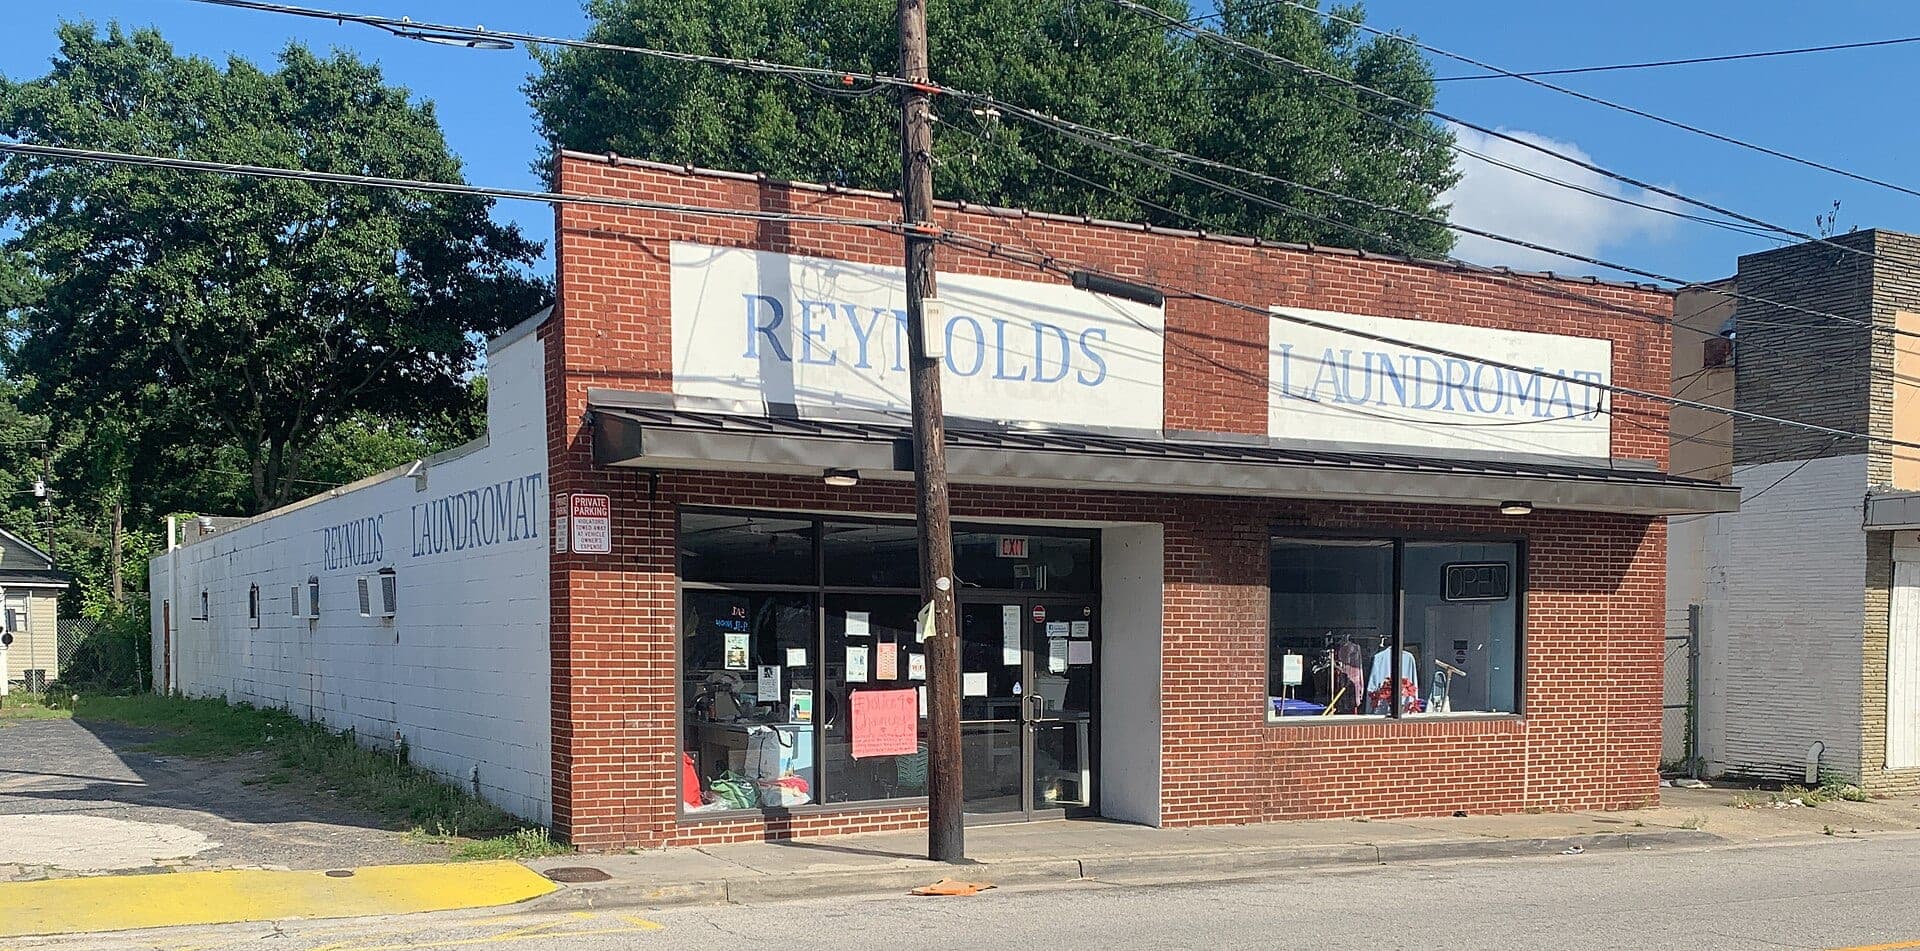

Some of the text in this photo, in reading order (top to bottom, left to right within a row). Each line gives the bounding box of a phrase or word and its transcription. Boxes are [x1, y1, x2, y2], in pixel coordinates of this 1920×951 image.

[1278, 342, 1602, 421] LAUNDROMAT
[574, 507, 608, 516] PARKING
[575, 497, 607, 507] PRIVATE
[323, 513, 384, 571] REYNOLDS
[411, 472, 542, 558] LAUNDROMAT
[1002, 538, 1025, 556] EXIT
[1449, 568, 1505, 597] OPEN
